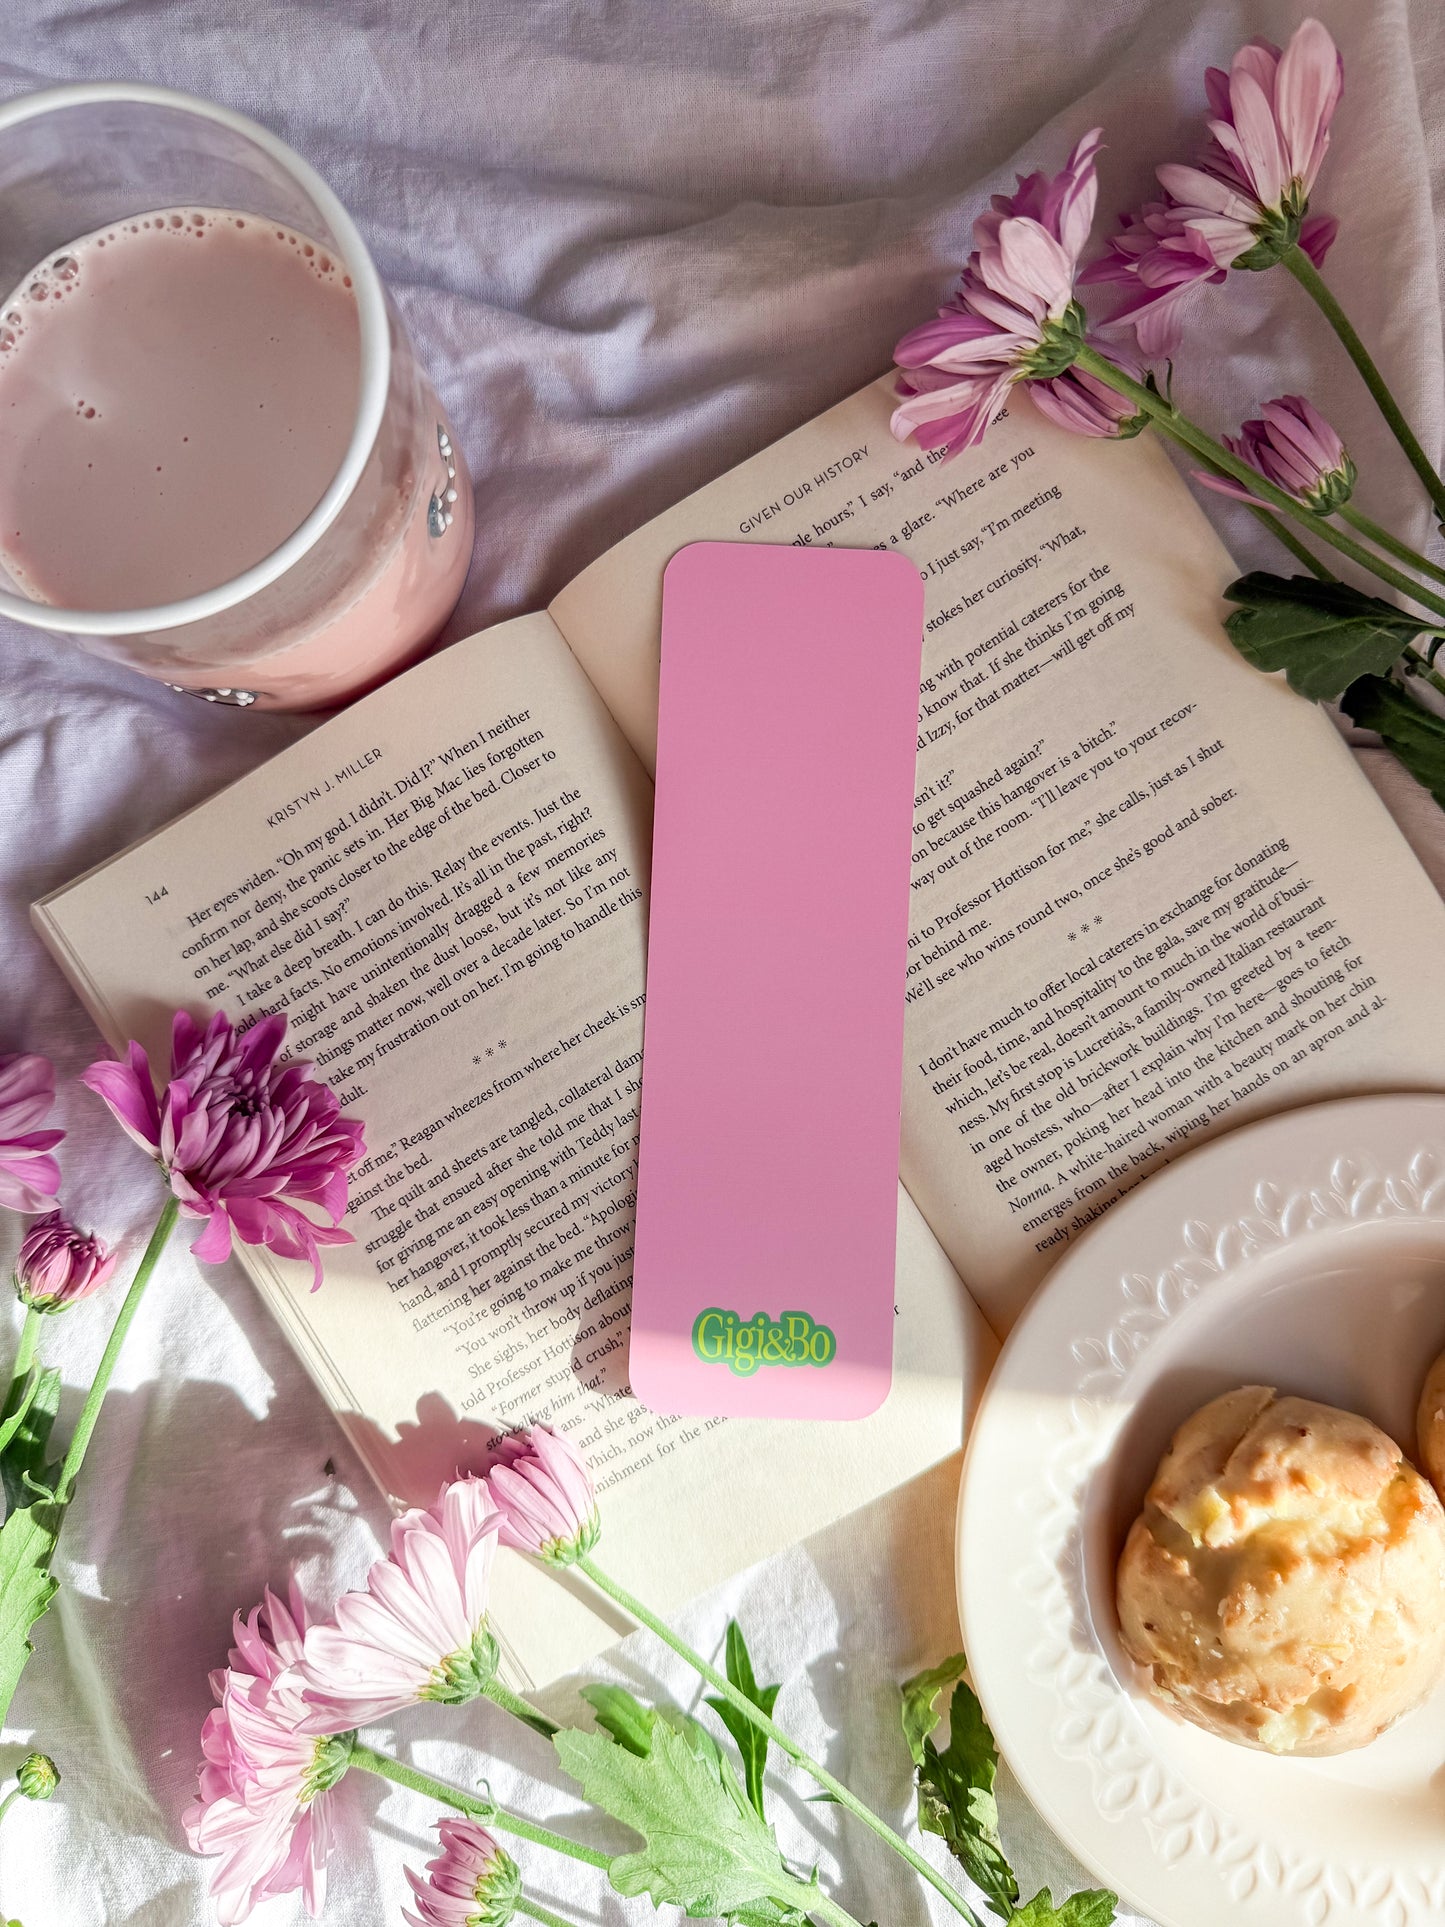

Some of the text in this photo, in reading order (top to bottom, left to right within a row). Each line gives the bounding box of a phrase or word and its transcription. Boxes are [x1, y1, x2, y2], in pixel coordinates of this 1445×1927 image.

[739, 444, 869, 534] GIVEN OUR HISTORY
[889, 446, 1035, 544] a glare. “Where are you
[925, 526, 1086, 633] stokes her curiosity. “What,
[934, 564, 1111, 681] with potential caterers for the
[181, 730, 545, 959] confirm nor deny, the panic sets in. Her Big Mac lies forgotten
[186, 709, 531, 928] Her eyes widen. “Oh my god. I didn’t. Did I?” When I neither
[266, 748, 383, 828] KRISTYN J. MILLER
[925, 816, 977, 852] because
[976, 800, 1002, 820] this
[999, 763, 1058, 805] hangover
[1057, 755, 1071, 768] is
[1071, 750, 1082, 760] a
[1077, 720, 1117, 754] bitch.”
[926, 807, 947, 829] get
[947, 768, 1004, 813] squashed
[1003, 738, 1045, 776] again?”
[144, 885, 169, 905] 144
[290, 828, 606, 1029] might have unintentionally dragged a few memories
[905, 788, 1237, 1004] We’ll see who wins round two, once she’s good and sober.
[315, 867, 631, 1066] things matter now, well over a decade later. So I’m not
[932, 860, 1299, 1095] their food, time, and hospitality to the gala, save my gratitude—
[957, 895, 1326, 1135] ness. My first stop is Lucretia’s, a family-owned Italian restaurant
[995, 955, 1363, 1193] the owner, poking her head into the kitchen and shouting for
[1007, 1183, 1055, 1214] Nonna.
[1056, 1171, 1069, 1185] A
[1067, 1120, 1147, 1176] white-haired
[1146, 1094, 1195, 1127] woman
[1192, 1074, 1224, 1097] with
[1223, 1069, 1234, 1079] a
[1230, 1041, 1274, 1073] beauty
[1274, 1019, 1309, 1046] mark
[1308, 1009, 1327, 1024] on
[1323, 993, 1347, 1012] her
[1348, 976, 1377, 997] chin
[375, 1107, 640, 1274] for giving me an easy opening with Teddy last
[412, 1190, 637, 1332] flattening her against the bed. “Apologi
[545, 1356, 584, 1388] stupid
[698, 1313, 830, 1371] Gigi&Bo
